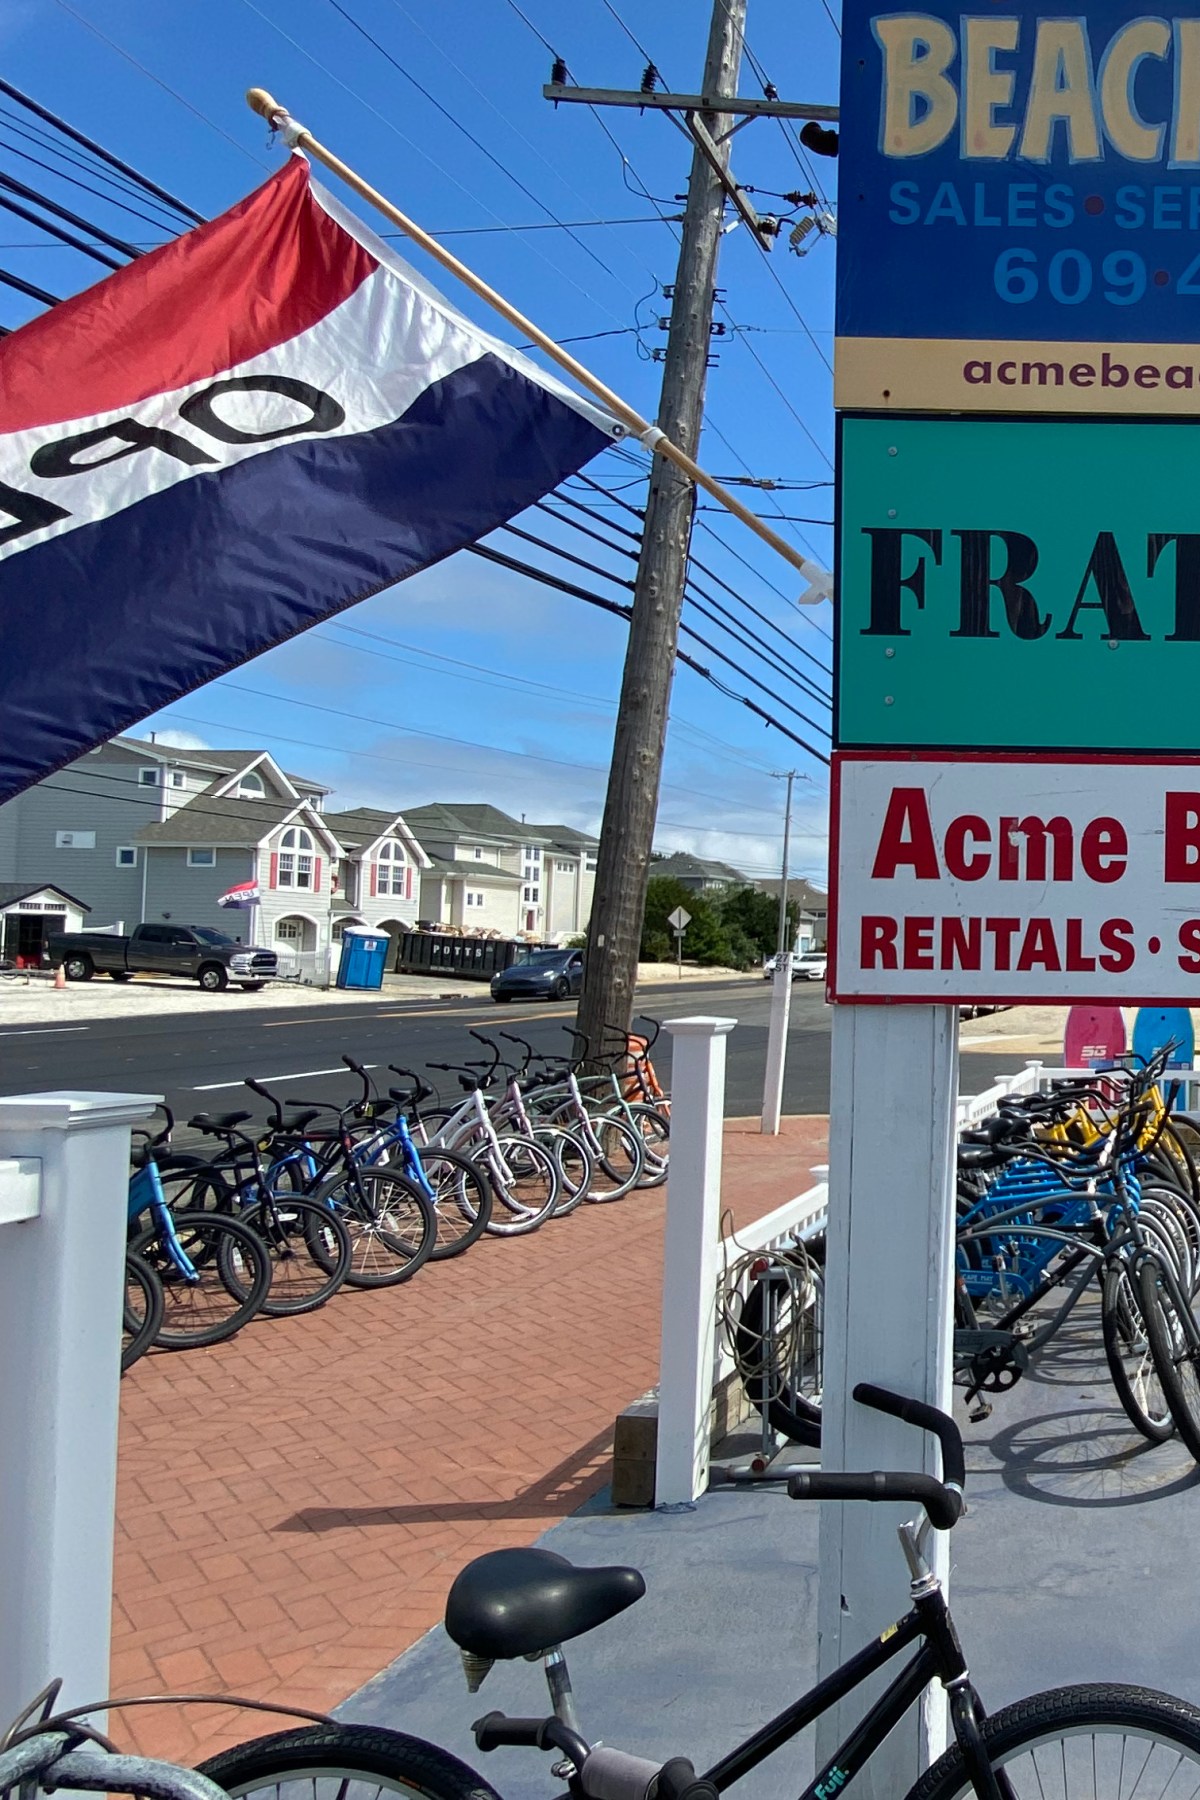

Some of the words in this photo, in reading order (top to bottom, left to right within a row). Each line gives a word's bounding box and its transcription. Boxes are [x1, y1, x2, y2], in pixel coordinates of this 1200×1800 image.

[888, 181, 1075, 227] SALES
[871, 787, 1128, 883] Acme
[433, 944, 482, 957] POTTS
[860, 915, 1135, 971] RENTALS
